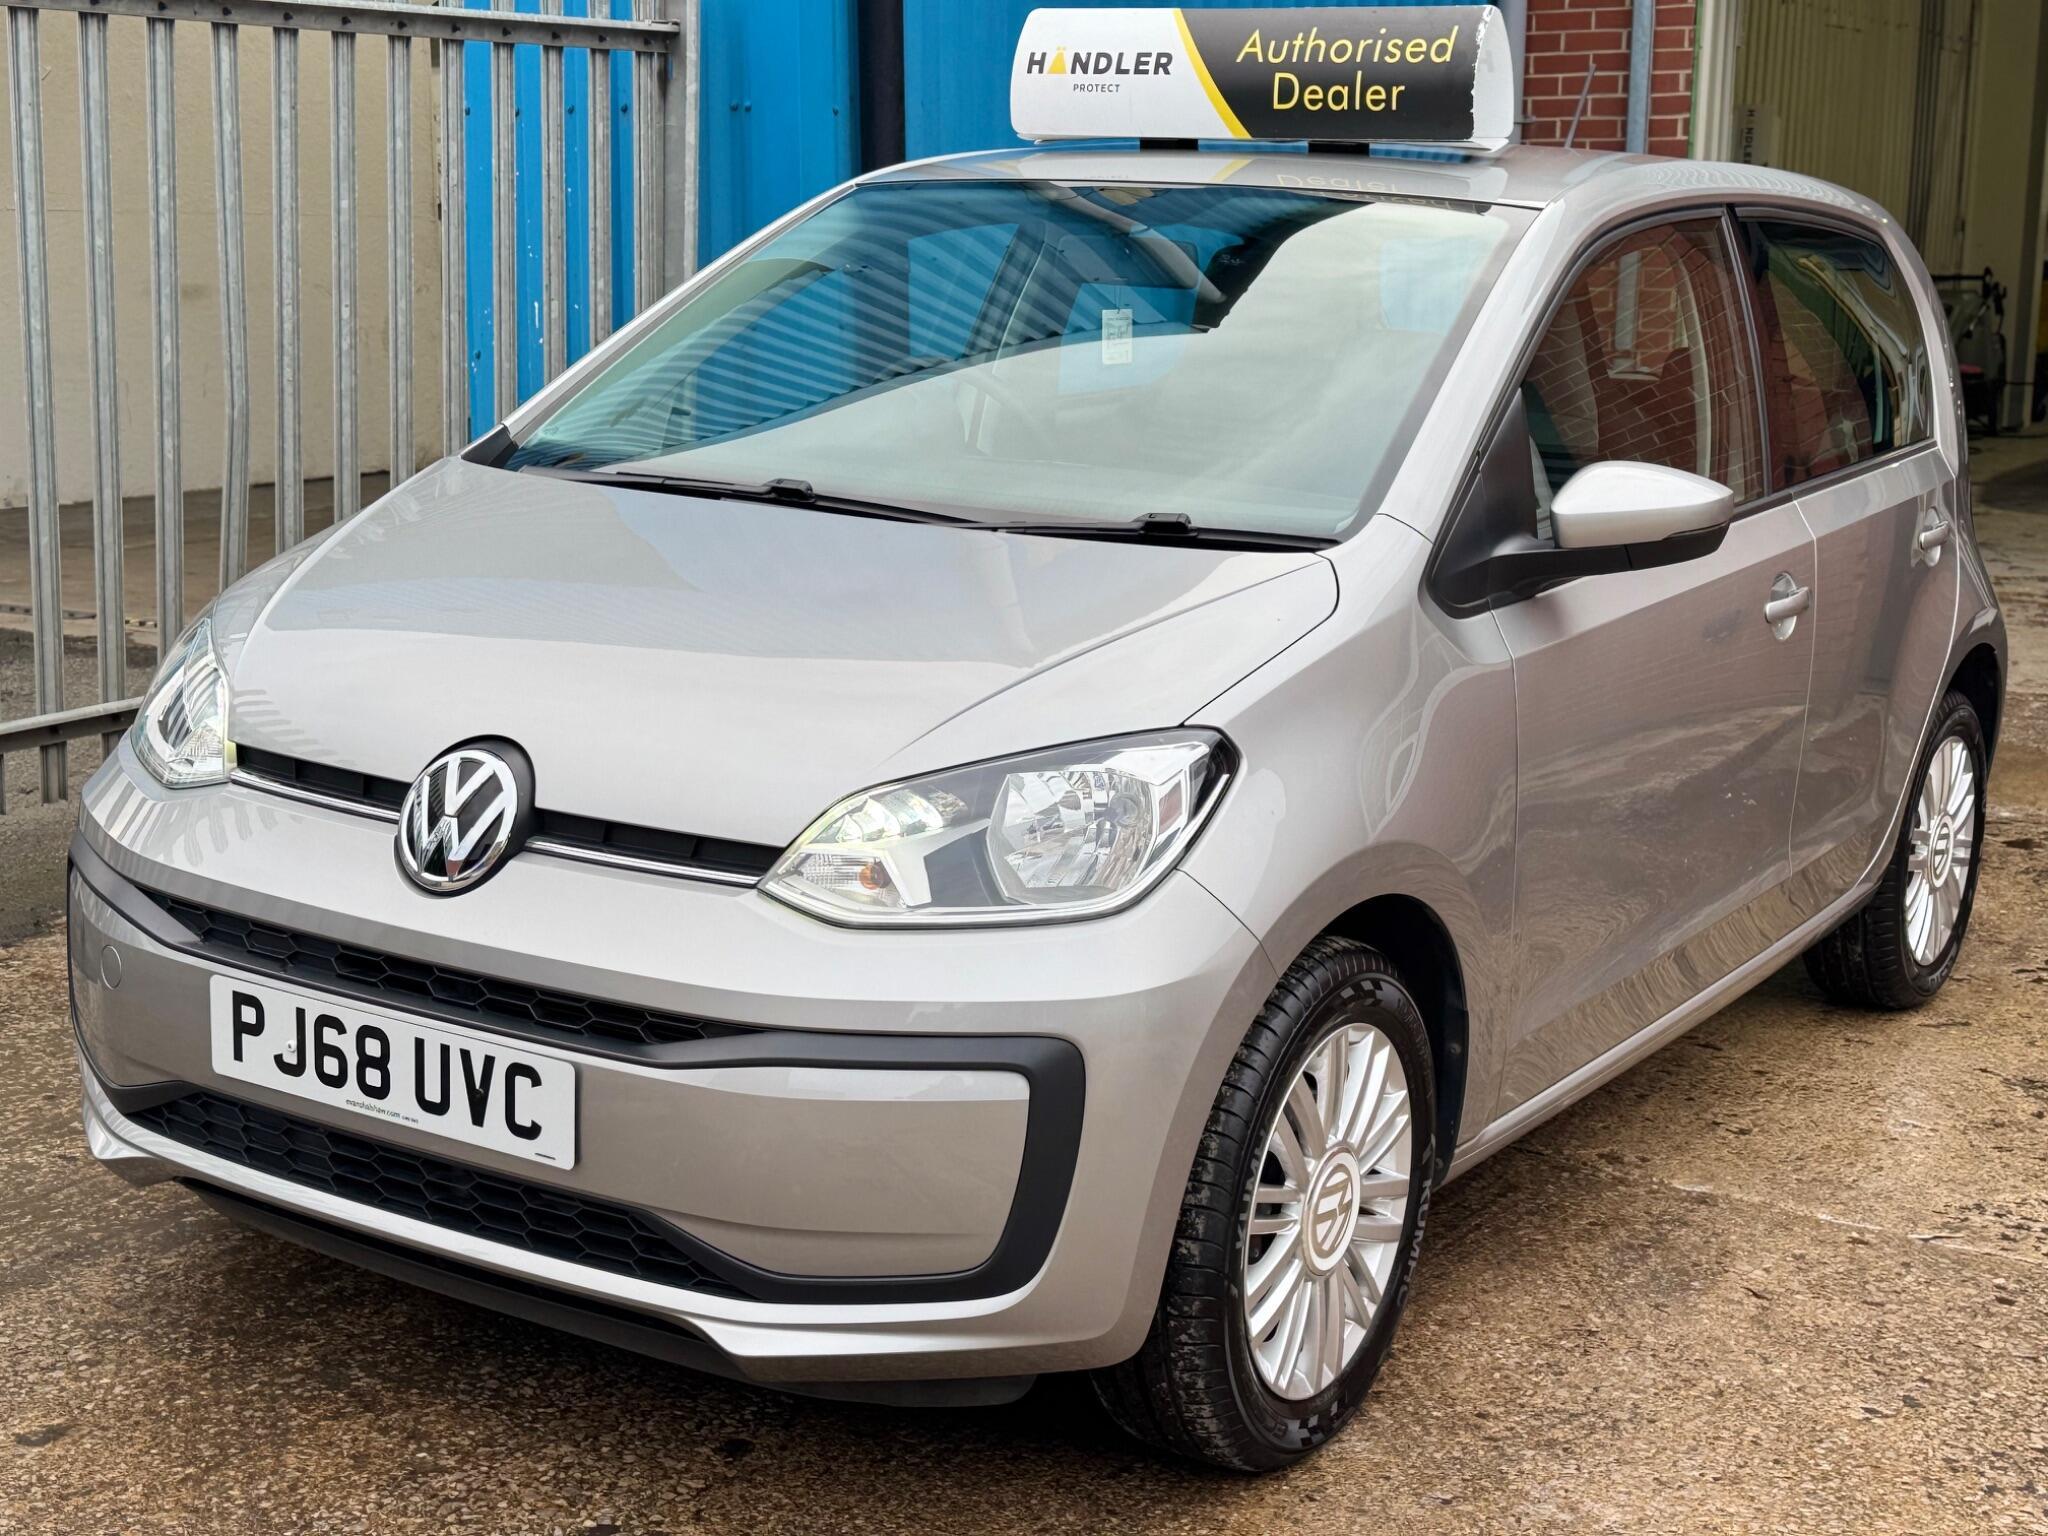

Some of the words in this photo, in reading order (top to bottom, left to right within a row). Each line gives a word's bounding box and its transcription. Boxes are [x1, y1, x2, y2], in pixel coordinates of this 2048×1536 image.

[1026, 46, 1174, 76] HÄNDLER
[1235, 25, 1459, 64] Authorised
[1073, 83, 1121, 93] PROTECT
[1273, 70, 1406, 111] Dealer
[232, 990, 391, 1100] PJ68
[414, 1036, 543, 1141] UVC
[1397, 1178, 1432, 1308] KUMHO
